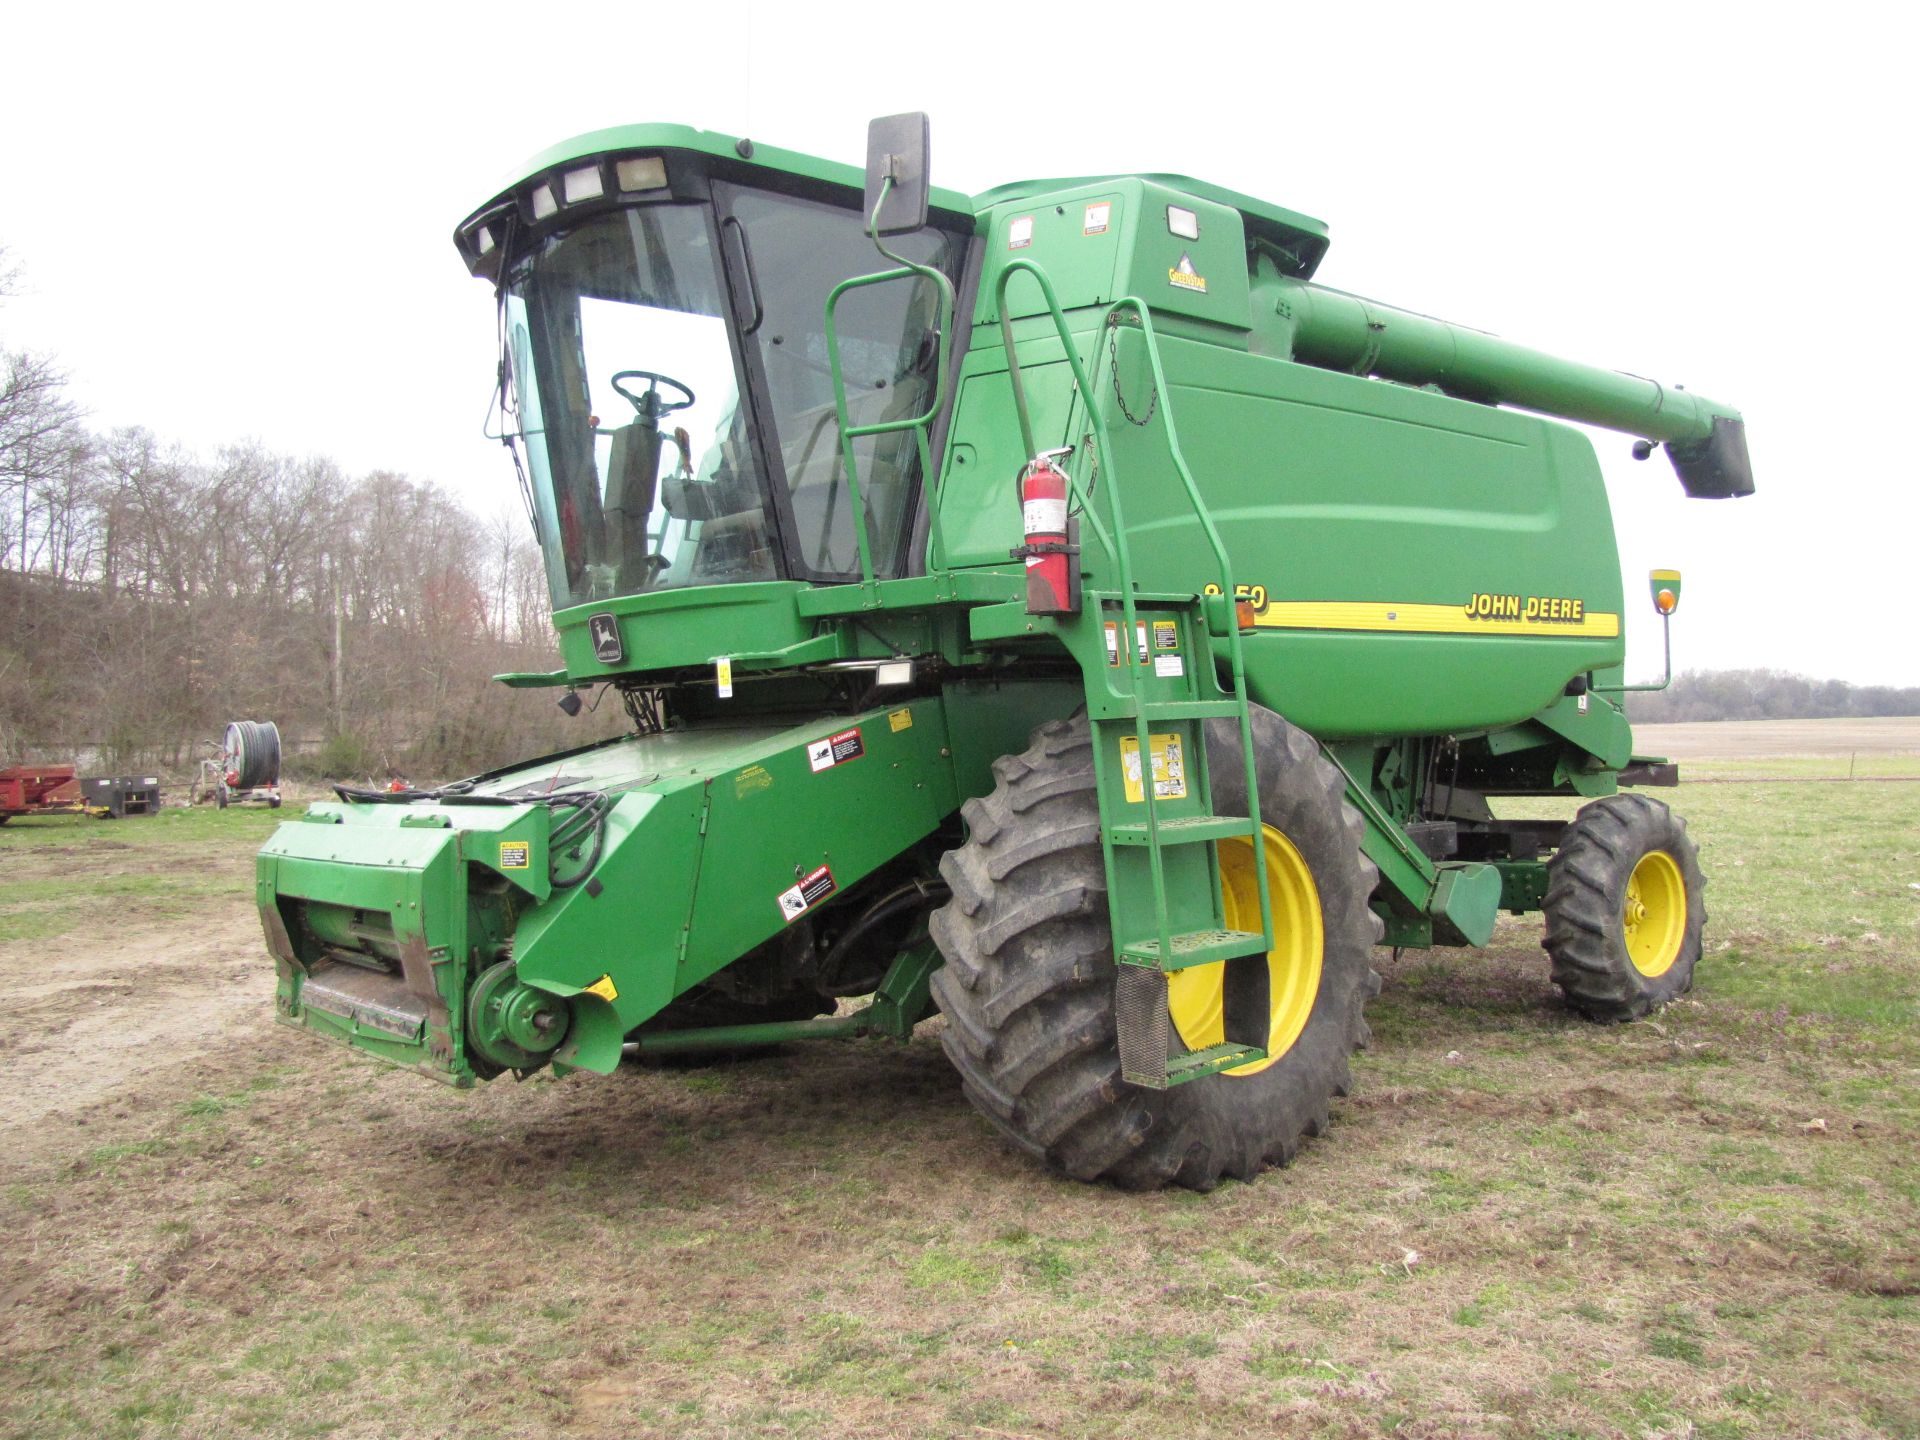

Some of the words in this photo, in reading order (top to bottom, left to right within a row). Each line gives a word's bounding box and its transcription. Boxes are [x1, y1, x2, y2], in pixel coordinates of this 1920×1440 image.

[1464, 593, 1521, 620] JOHN
[1526, 596, 1584, 623] DEERE
[837, 730, 857, 741] DANGER
